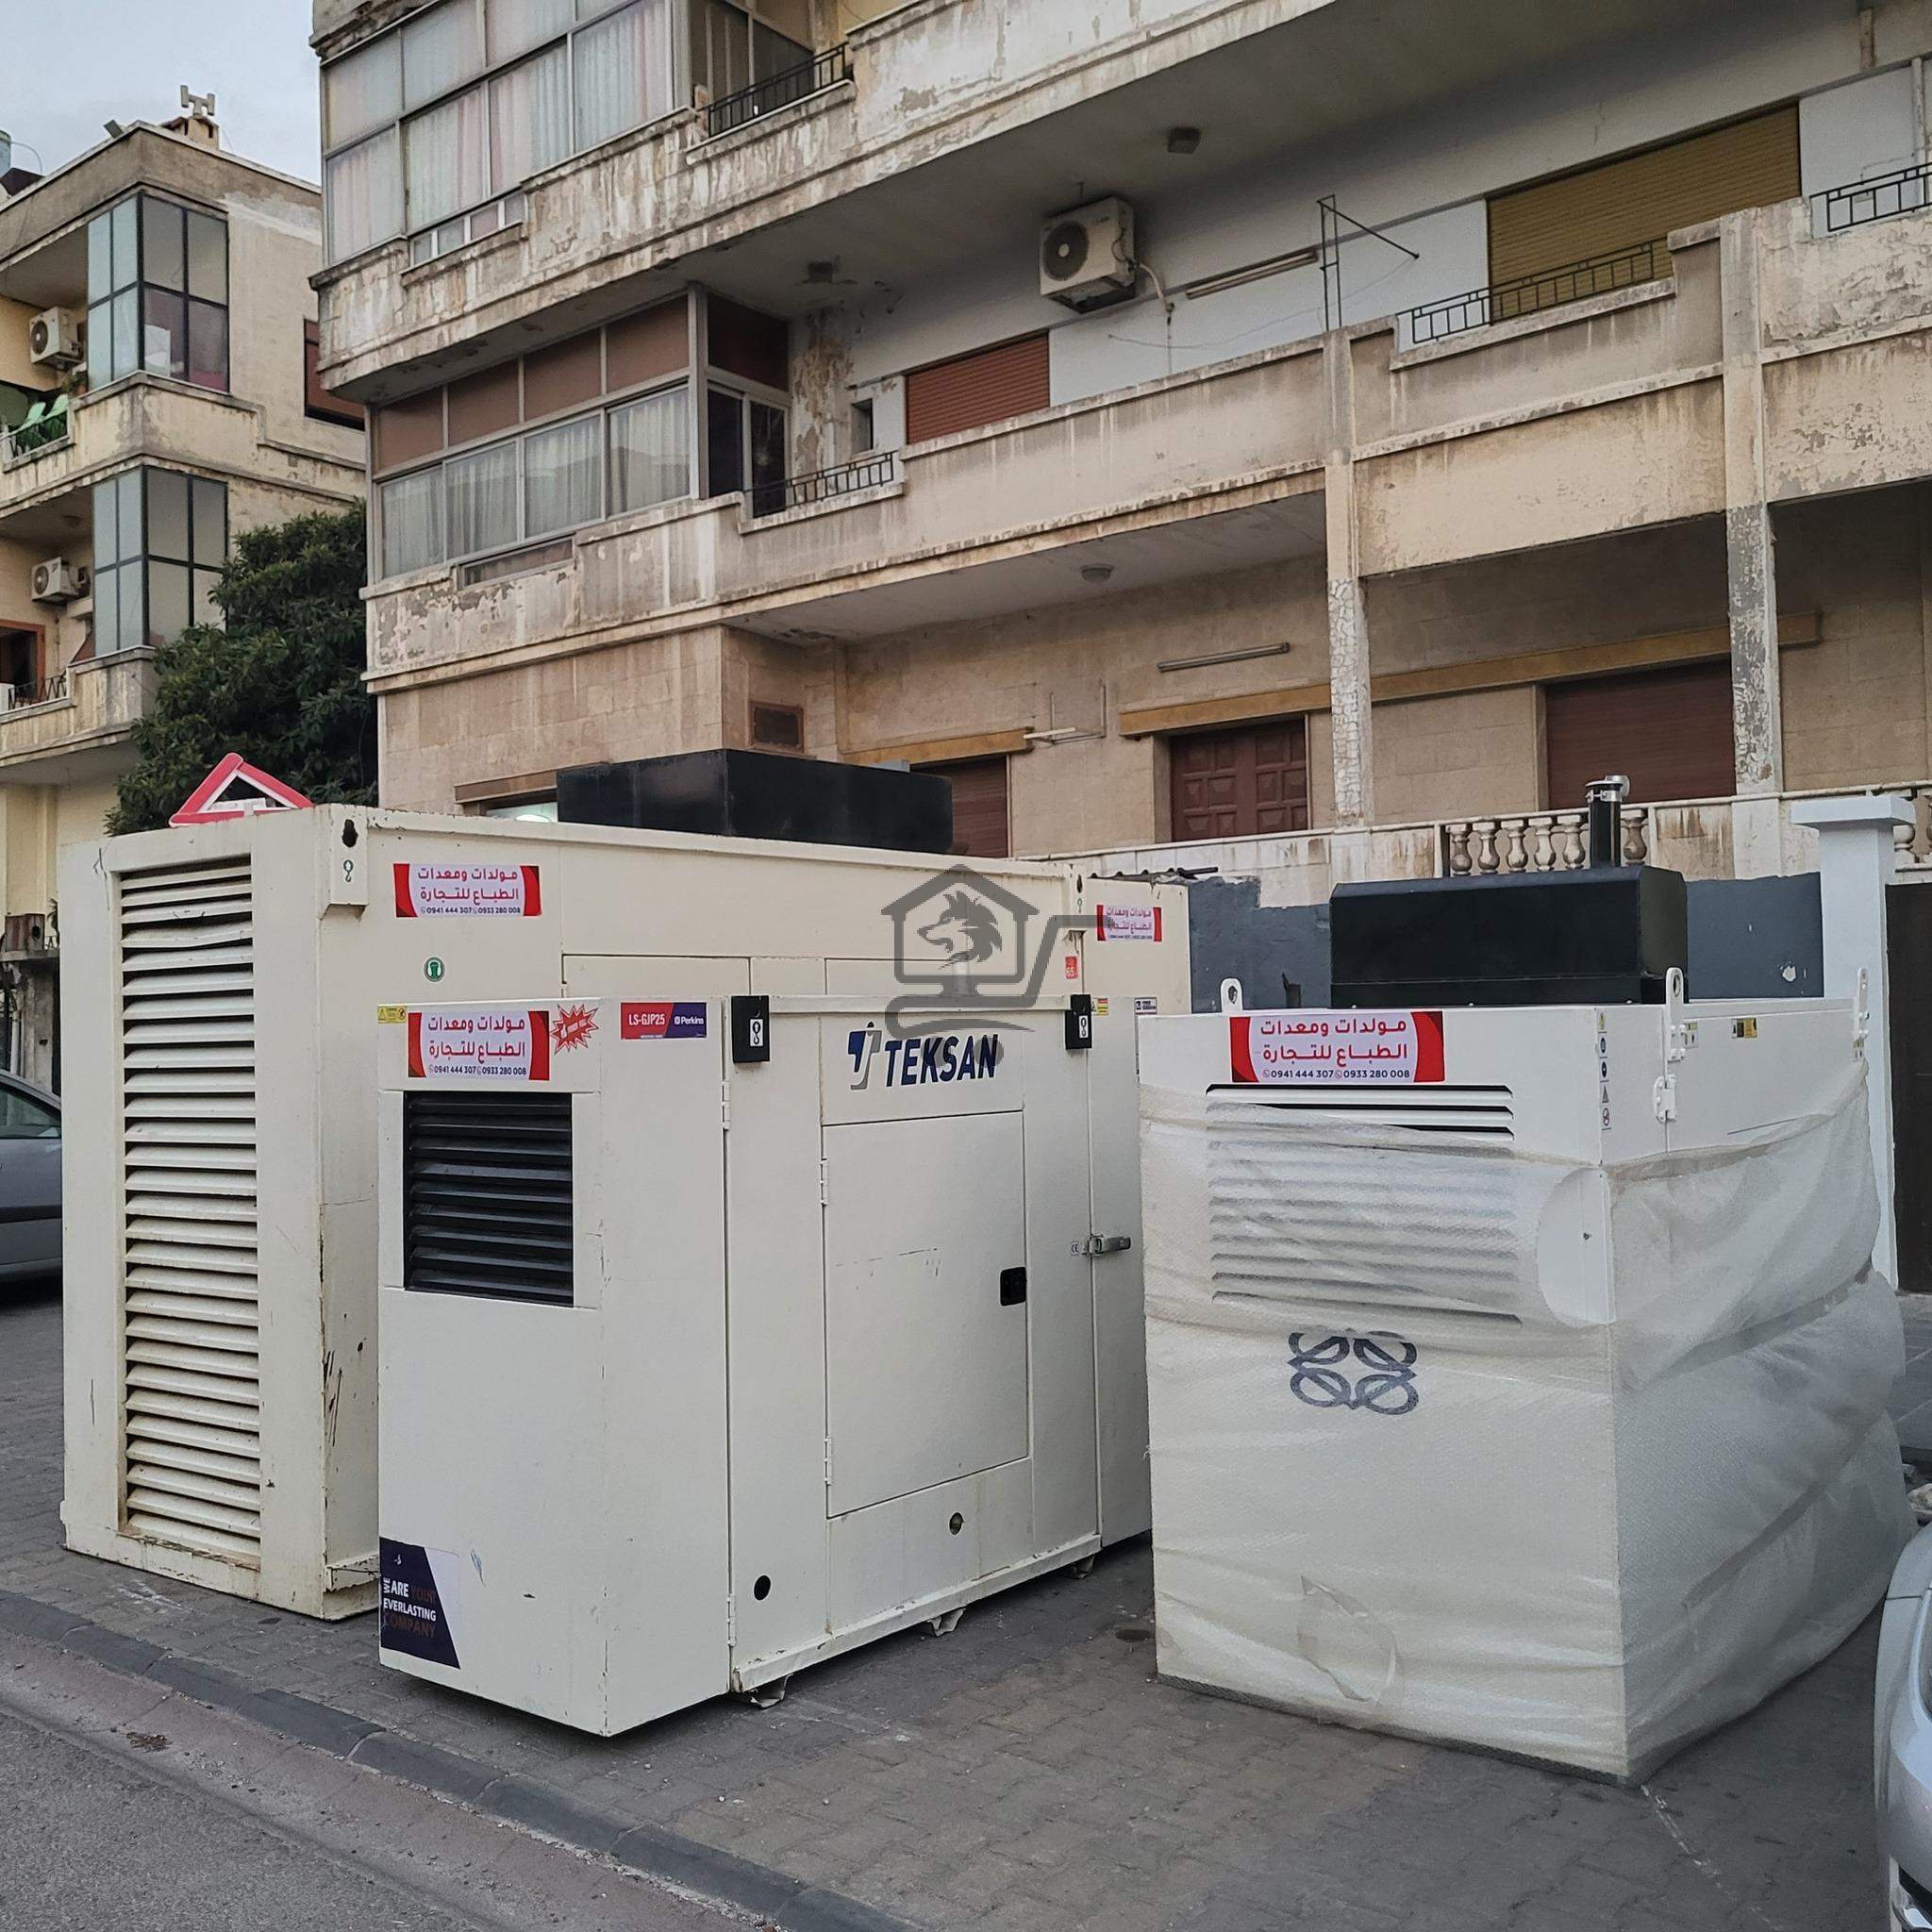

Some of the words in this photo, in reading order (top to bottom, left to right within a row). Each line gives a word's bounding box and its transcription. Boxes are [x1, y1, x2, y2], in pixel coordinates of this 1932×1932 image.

[418, 868, 468, 882] ومعدات
[471, 869, 518, 882] مولدات
[420, 887, 470, 903] للتجارة
[473, 888, 519, 905] الطباع
[427, 1017, 474, 1033] ومعدات
[477, 1015, 525, 1033] مولدات
[680, 1015, 705, 1025] Perkins
[1260, 1020, 1328, 1037] ومعدات
[1335, 1017, 1407, 1036] مولدات
[429, 1040, 475, 1060] للتجارة
[478, 1041, 525, 1064] الطباع
[1263, 1043, 1332, 1064] للتجارة
[1336, 1042, 1407, 1067] الطباع
[884, 1034, 999, 1087] TEKSAN
[434, 1065, 450, 1074] 0941
[451, 1065, 463, 1074] 444
[464, 1066, 476, 1074] 307
[482, 1066, 499, 1075] 0933
[499, 1066, 512, 1075] 280
[512, 1067, 526, 1075] 008
[1271, 1070, 1293, 1078] 0941
[1294, 1070, 1314, 1078] 444
[1316, 1070, 1334, 1078] 307
[1343, 1070, 1368, 1078] 0933
[1369, 1070, 1389, 1078] 280
[1390, 1070, 1410, 1078] 008
[391, 1580, 409, 1598] ARE
[383, 1597, 437, 1622] EVERLASTING
